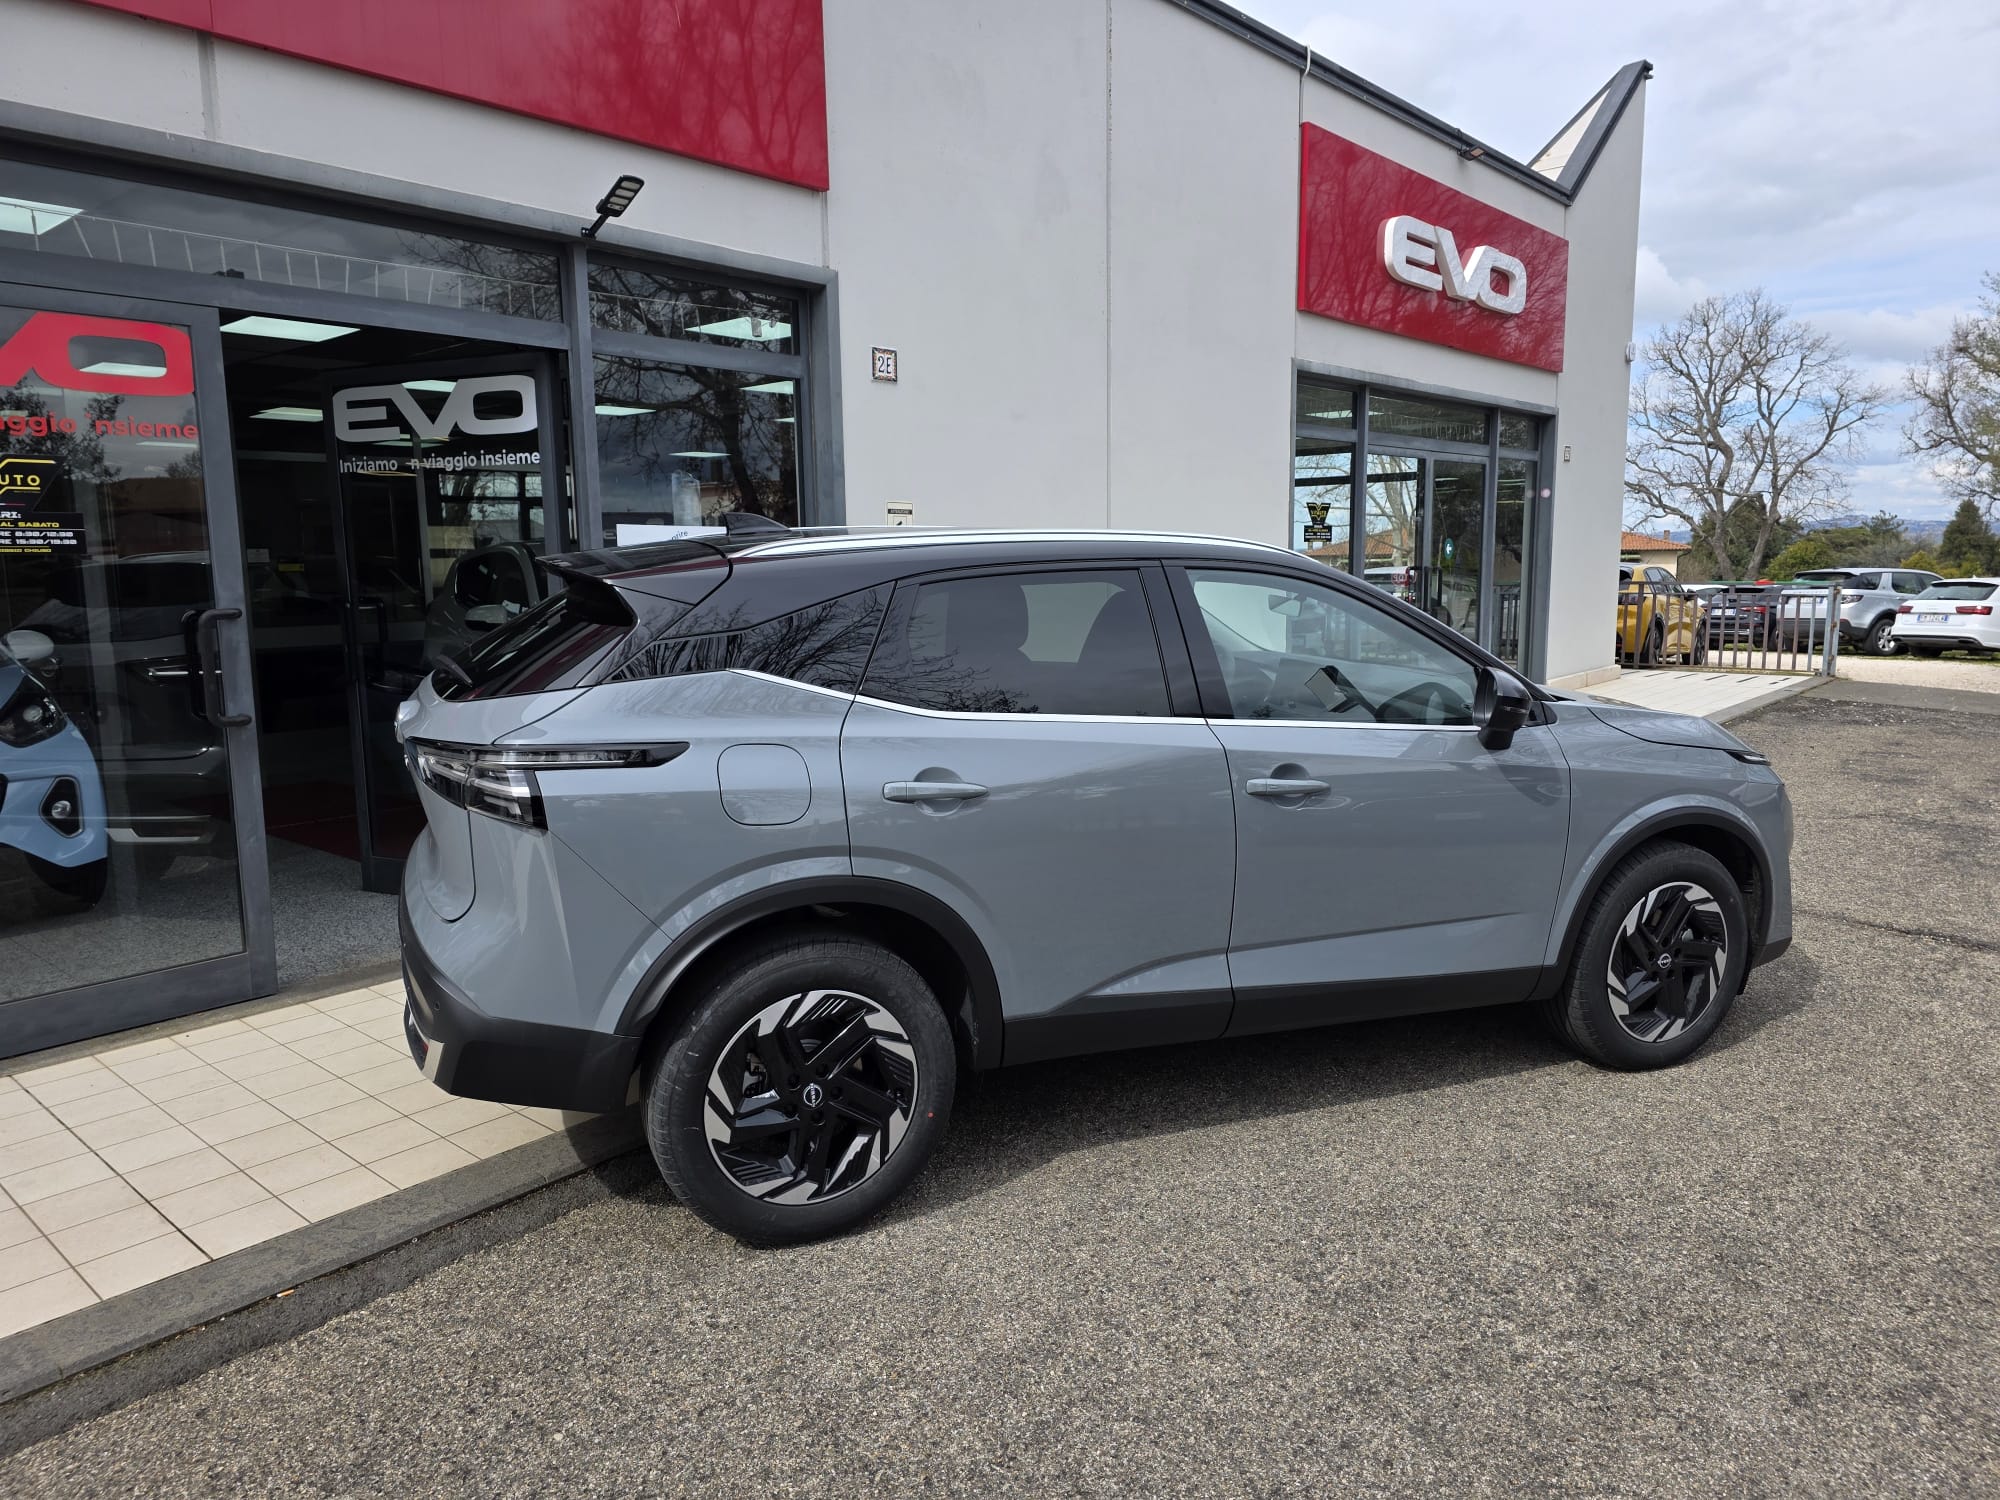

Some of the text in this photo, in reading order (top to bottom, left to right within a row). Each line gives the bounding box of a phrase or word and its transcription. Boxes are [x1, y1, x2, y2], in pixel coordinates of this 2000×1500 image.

[1383, 214, 1528, 315] EVO
[877, 355, 892, 374] 2E
[332, 374, 538, 442] EVO
[339, 456, 398, 473] Iniziamo
[423, 453, 477, 472] viaggio
[480, 449, 541, 466] insieme
